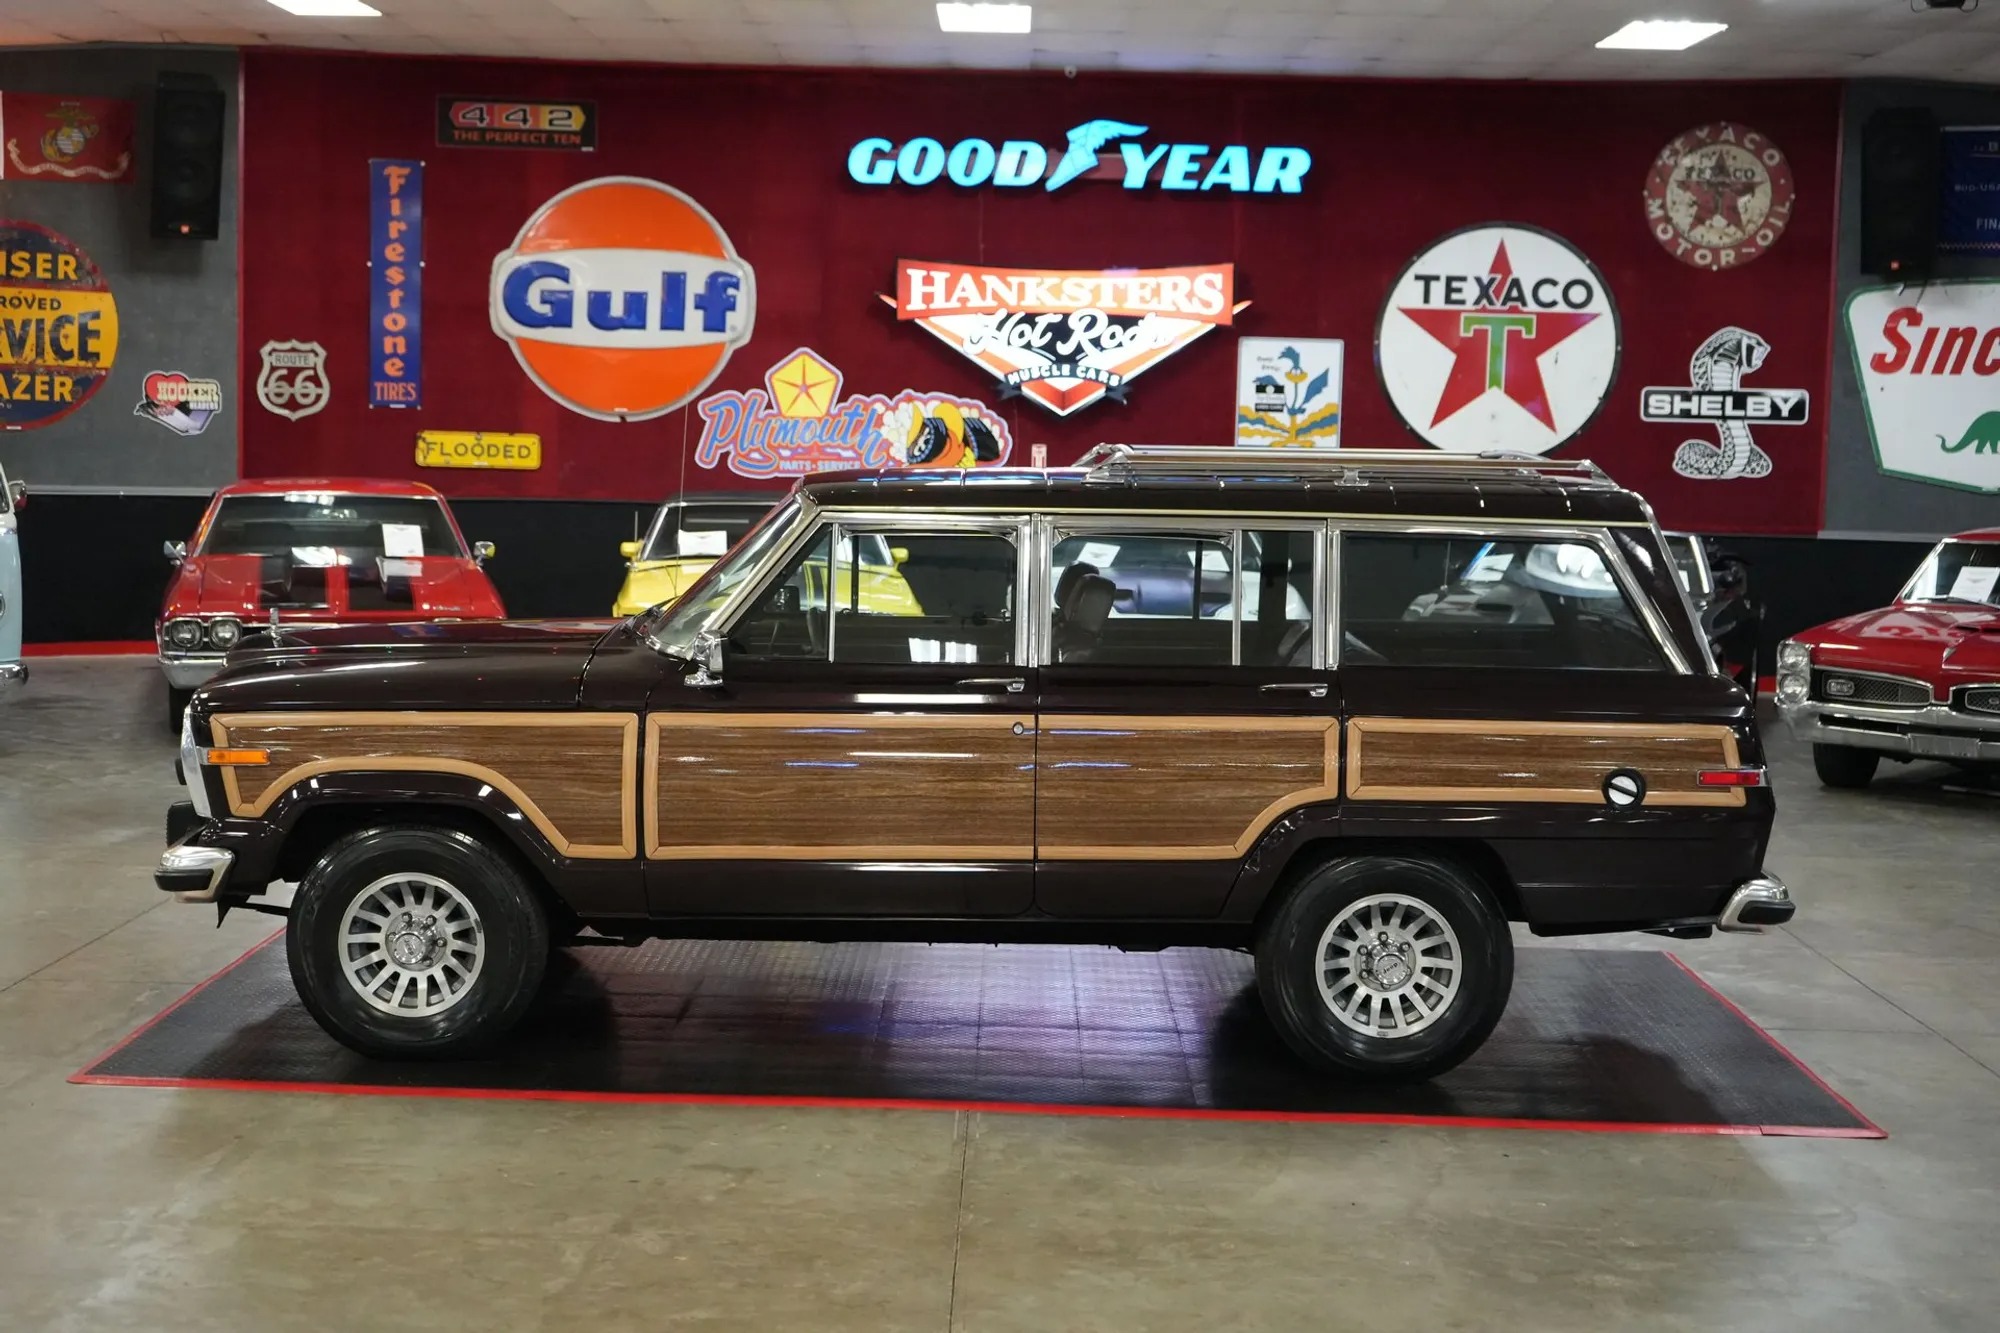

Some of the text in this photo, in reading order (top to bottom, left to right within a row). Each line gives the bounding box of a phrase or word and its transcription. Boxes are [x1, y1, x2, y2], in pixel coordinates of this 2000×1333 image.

[453, 130, 581, 144] THE PERFECT TEN
[847, 137, 1312, 194] GOOD YEAR
[383, 165, 412, 378] Firestone
[502, 260, 741, 333] Gulf
[905, 267, 1224, 316] HANKSTERS
[1414, 273, 1594, 310] TEXACO
[0, 310, 101, 363] VICE
[963, 307, 1064, 355] Hot
[274, 354, 310, 366] ROUTE
[1007, 364, 1121, 386] MUSCLE CARS
[267, 368, 316, 406] 66
[374, 382, 417, 401] TIRES
[1648, 394, 1800, 418] SHELBY
[425, 441, 531, 459] FLOODED
[704, 397, 886, 471] Plymouth
